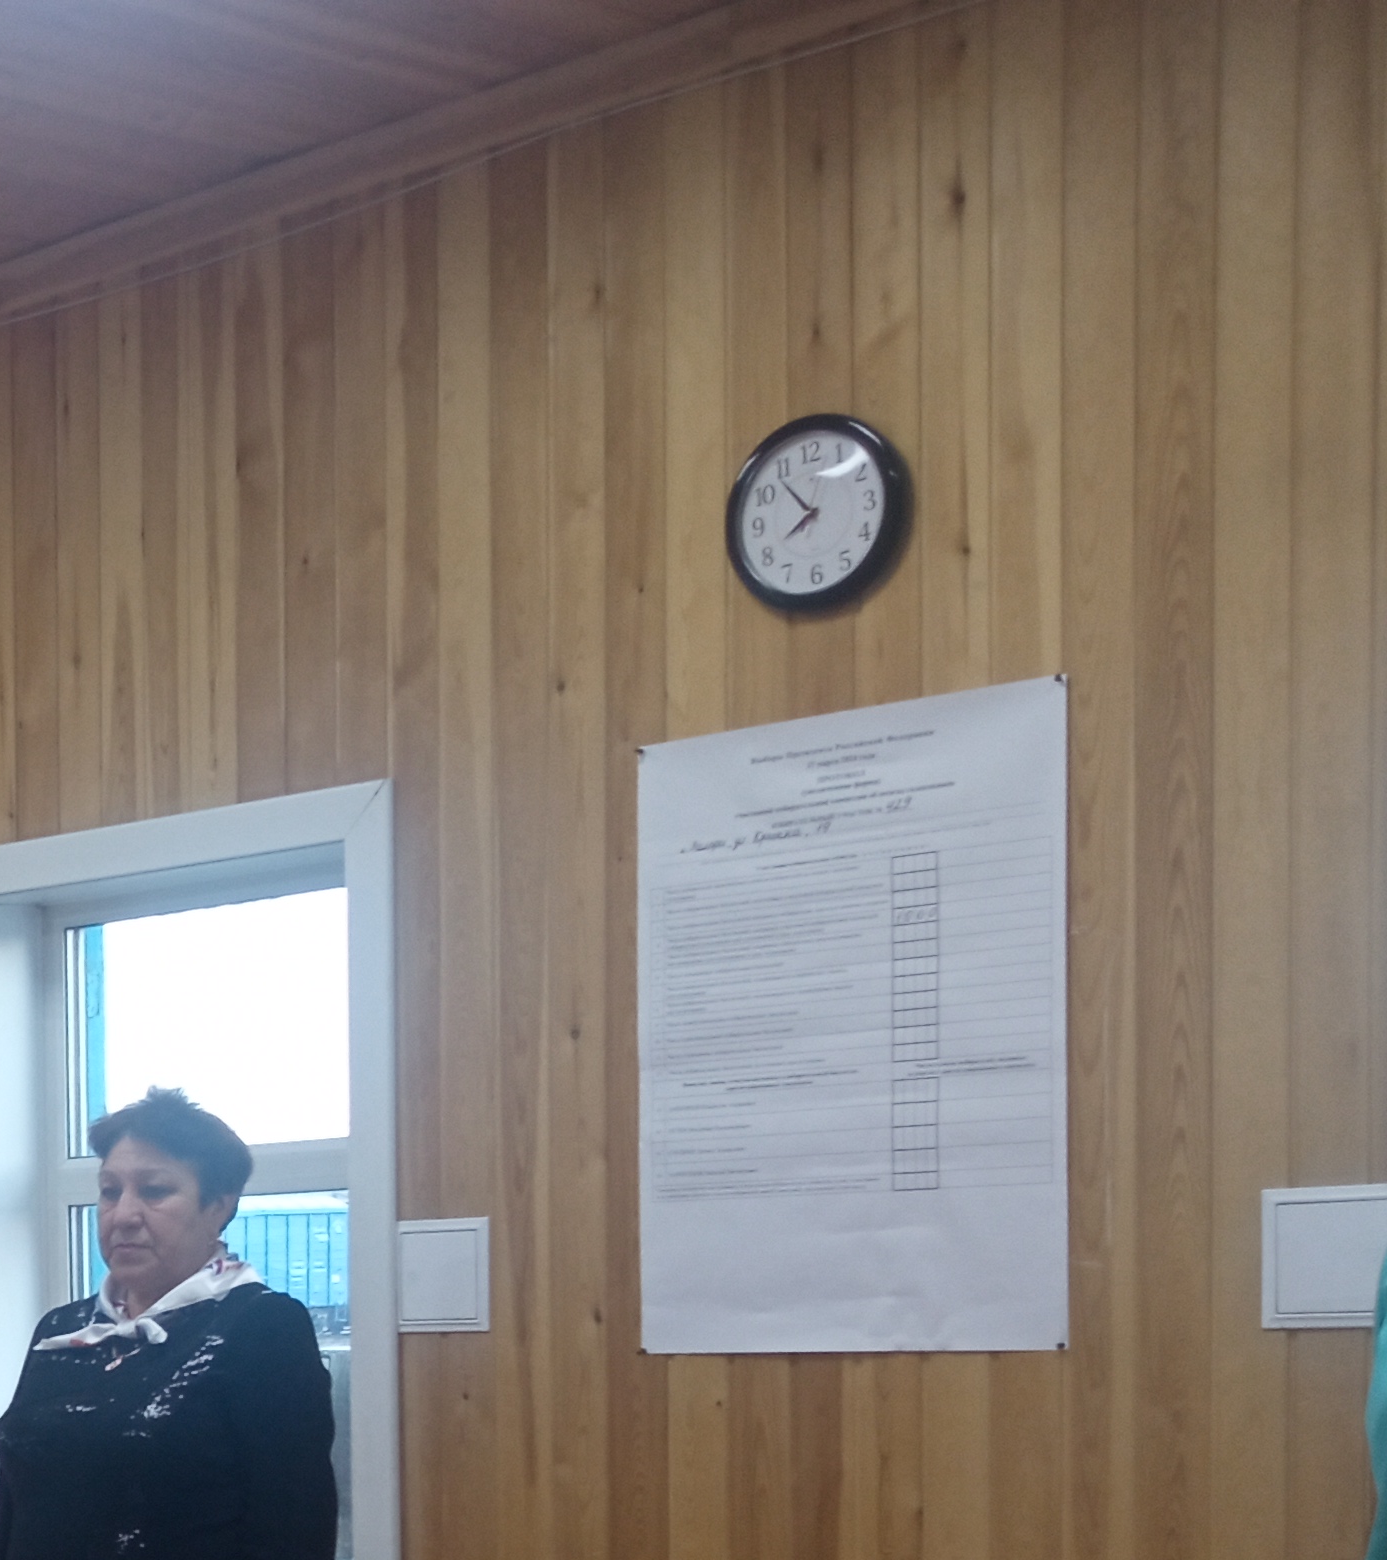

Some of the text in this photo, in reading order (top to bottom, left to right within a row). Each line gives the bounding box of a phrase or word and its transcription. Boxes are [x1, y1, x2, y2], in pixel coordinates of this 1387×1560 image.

[801, 441, 820, 464] 12
[835, 443, 844, 463] 1
[778, 457, 792, 479] 11
[855, 463, 867, 482] 2
[755, 484, 776, 506] 10
[863, 490, 876, 511] 3
[752, 517, 764, 538] 9
[858, 521, 871, 541] 4
[762, 547, 774, 567] 8
[839, 550, 851, 571] 5
[781, 563, 793, 583] 7
[810, 564, 823, 584] 6
